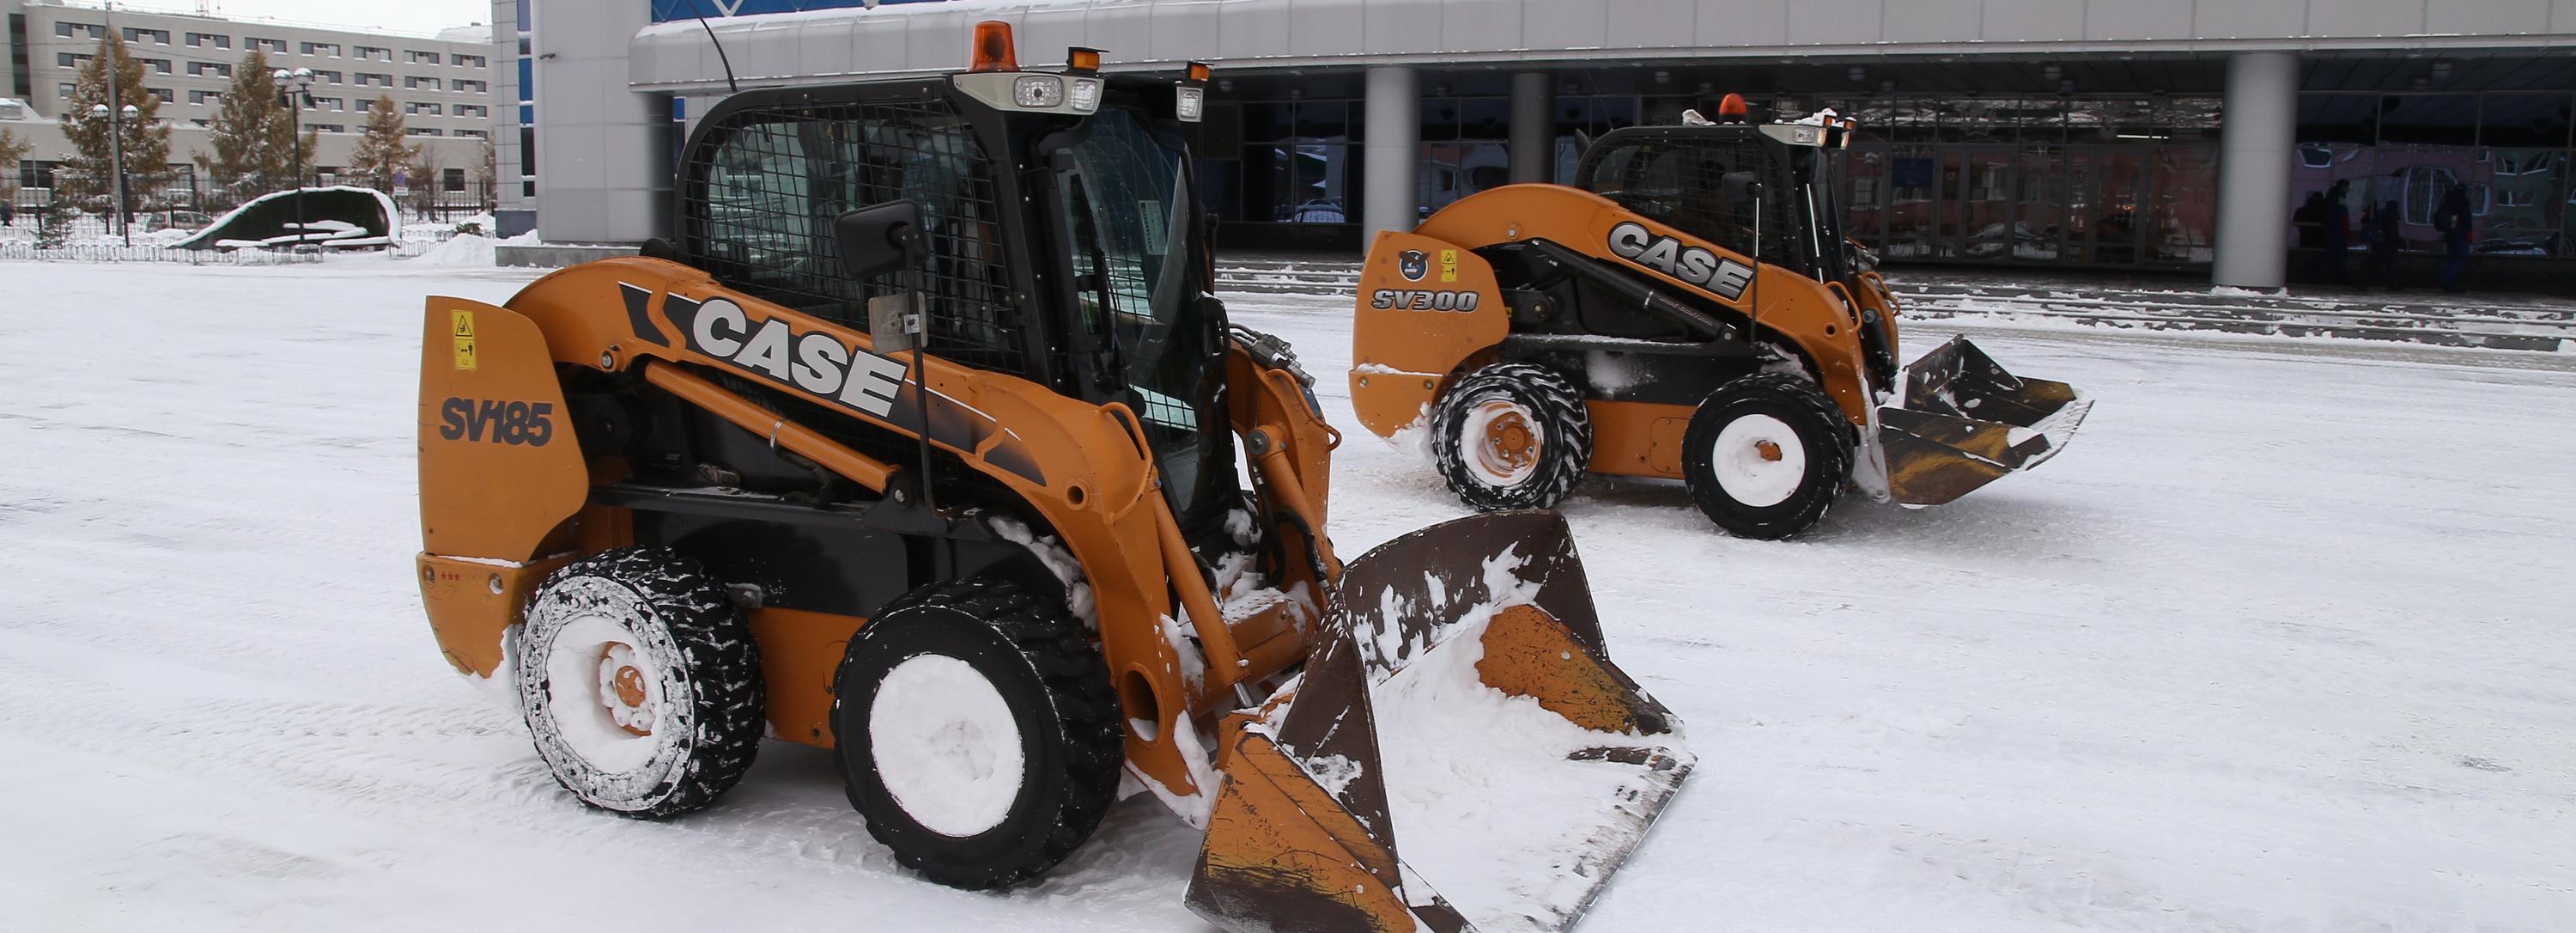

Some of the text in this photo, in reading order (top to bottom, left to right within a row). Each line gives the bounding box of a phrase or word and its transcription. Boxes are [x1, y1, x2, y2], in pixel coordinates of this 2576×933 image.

[1608, 224, 1753, 299] CASE
[1372, 289, 1479, 311] SV300
[693, 300, 908, 417] CASE
[440, 398, 553, 447] SV185
